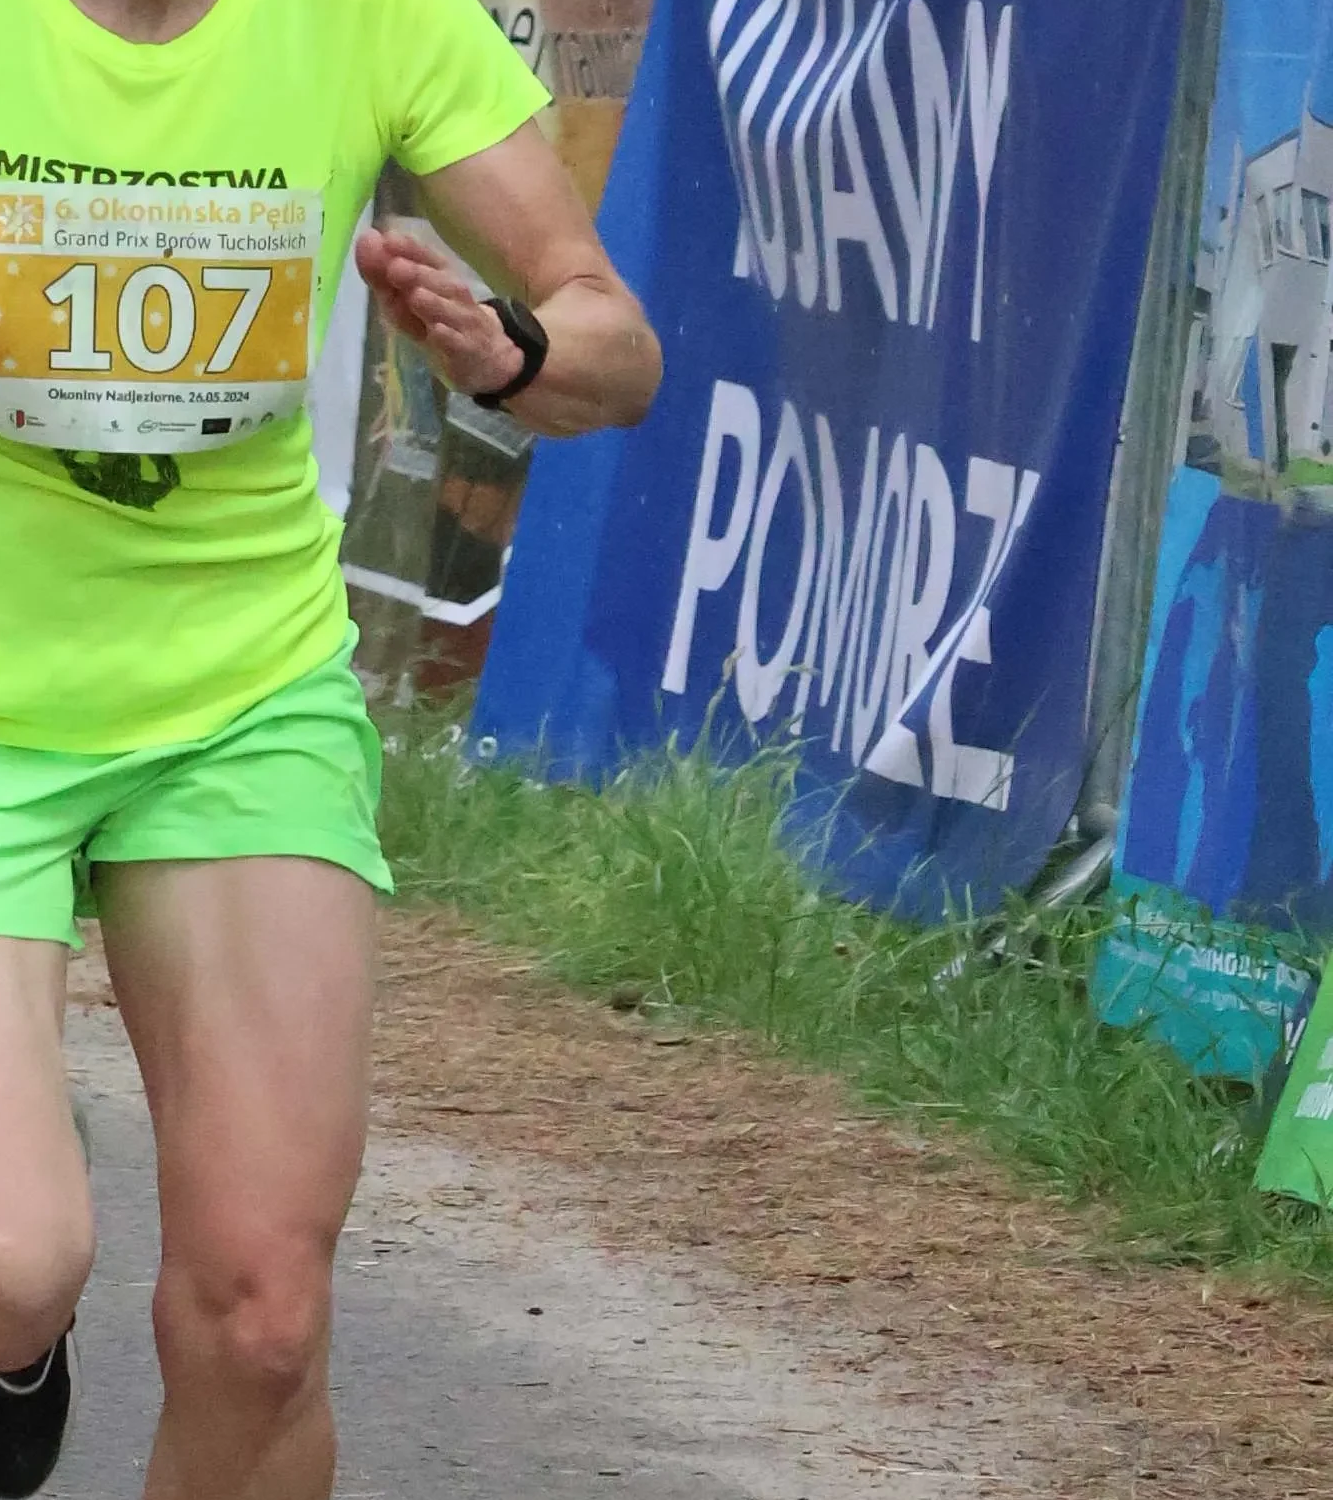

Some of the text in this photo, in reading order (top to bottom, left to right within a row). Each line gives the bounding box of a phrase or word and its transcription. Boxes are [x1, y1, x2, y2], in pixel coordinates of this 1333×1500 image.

[88, 197, 242, 225] Okonińska
[54, 229, 307, 252] Grand Prix Borów Tucholskich
[42, 262, 273, 375] 107
[47, 387, 102, 403] Okoniny
